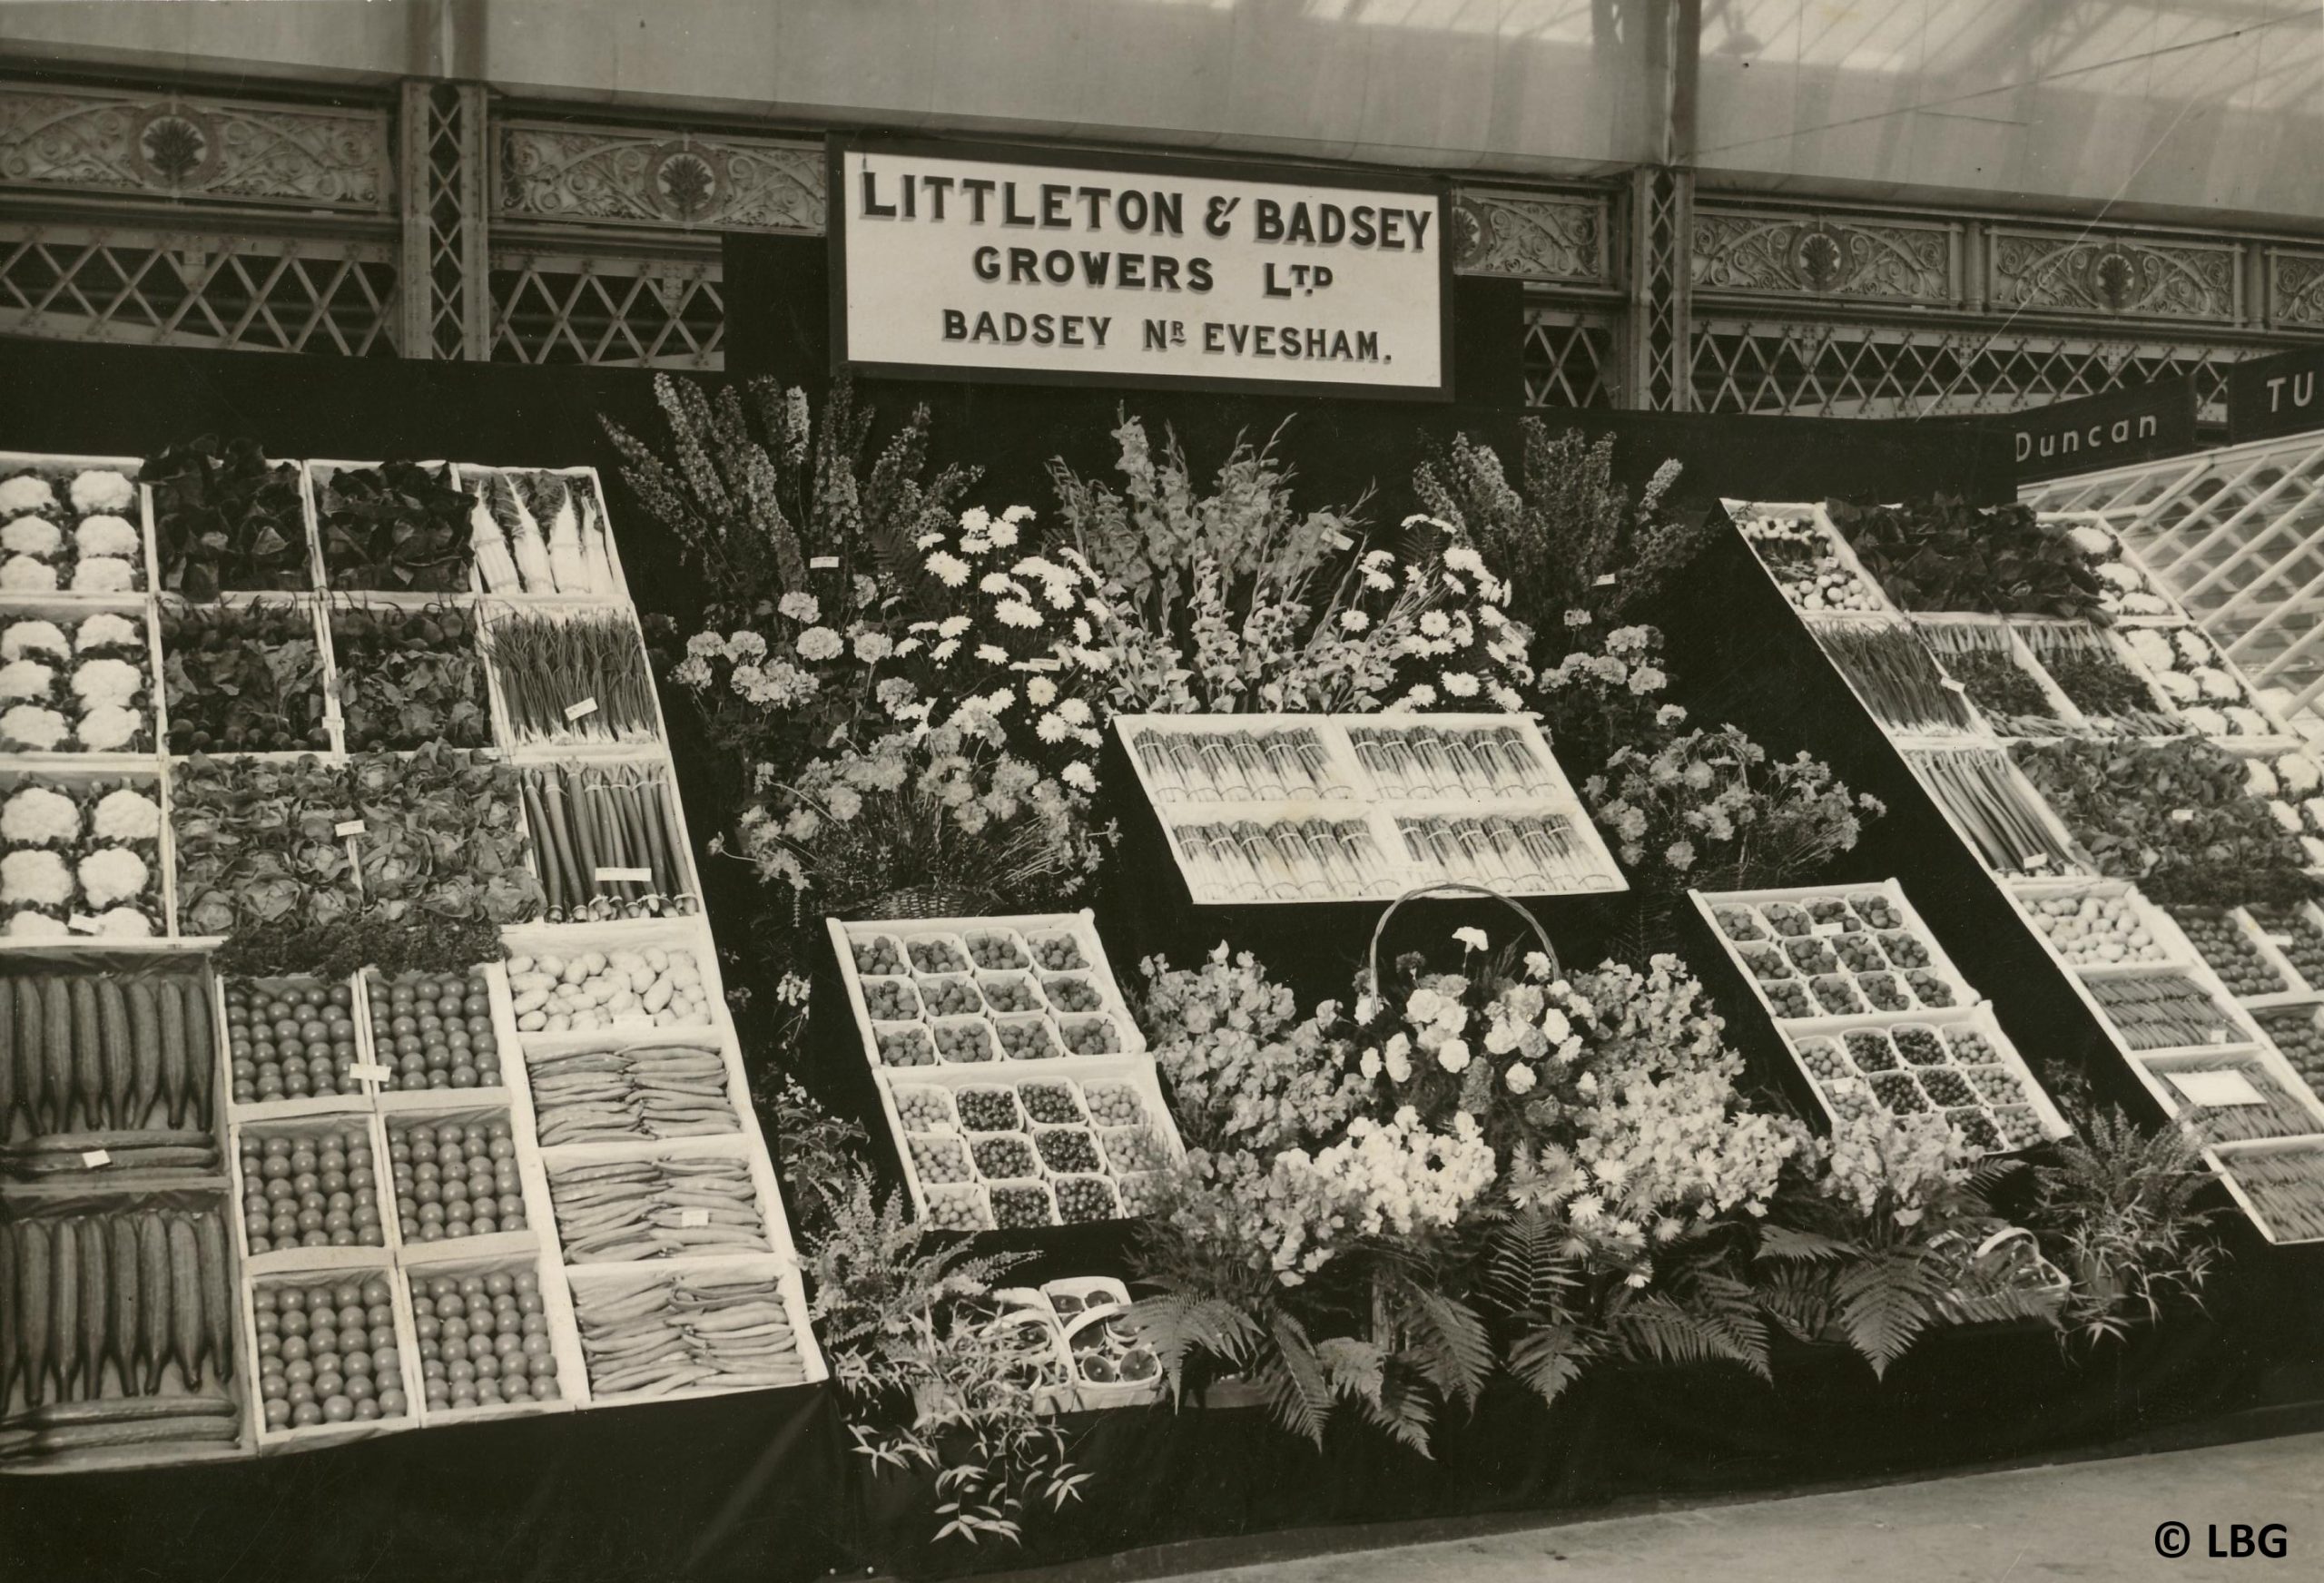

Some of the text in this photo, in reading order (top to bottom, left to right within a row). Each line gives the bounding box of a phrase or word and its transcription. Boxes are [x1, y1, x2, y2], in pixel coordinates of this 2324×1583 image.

[861, 170, 1433, 252] LITTLETON & BADSEY
[972, 244, 1215, 293] GROWERS
[941, 308, 1113, 348] BADSEY
[1203, 321, 1393, 364] EVESHAM.
[2014, 414, 2158, 463] Duncan
